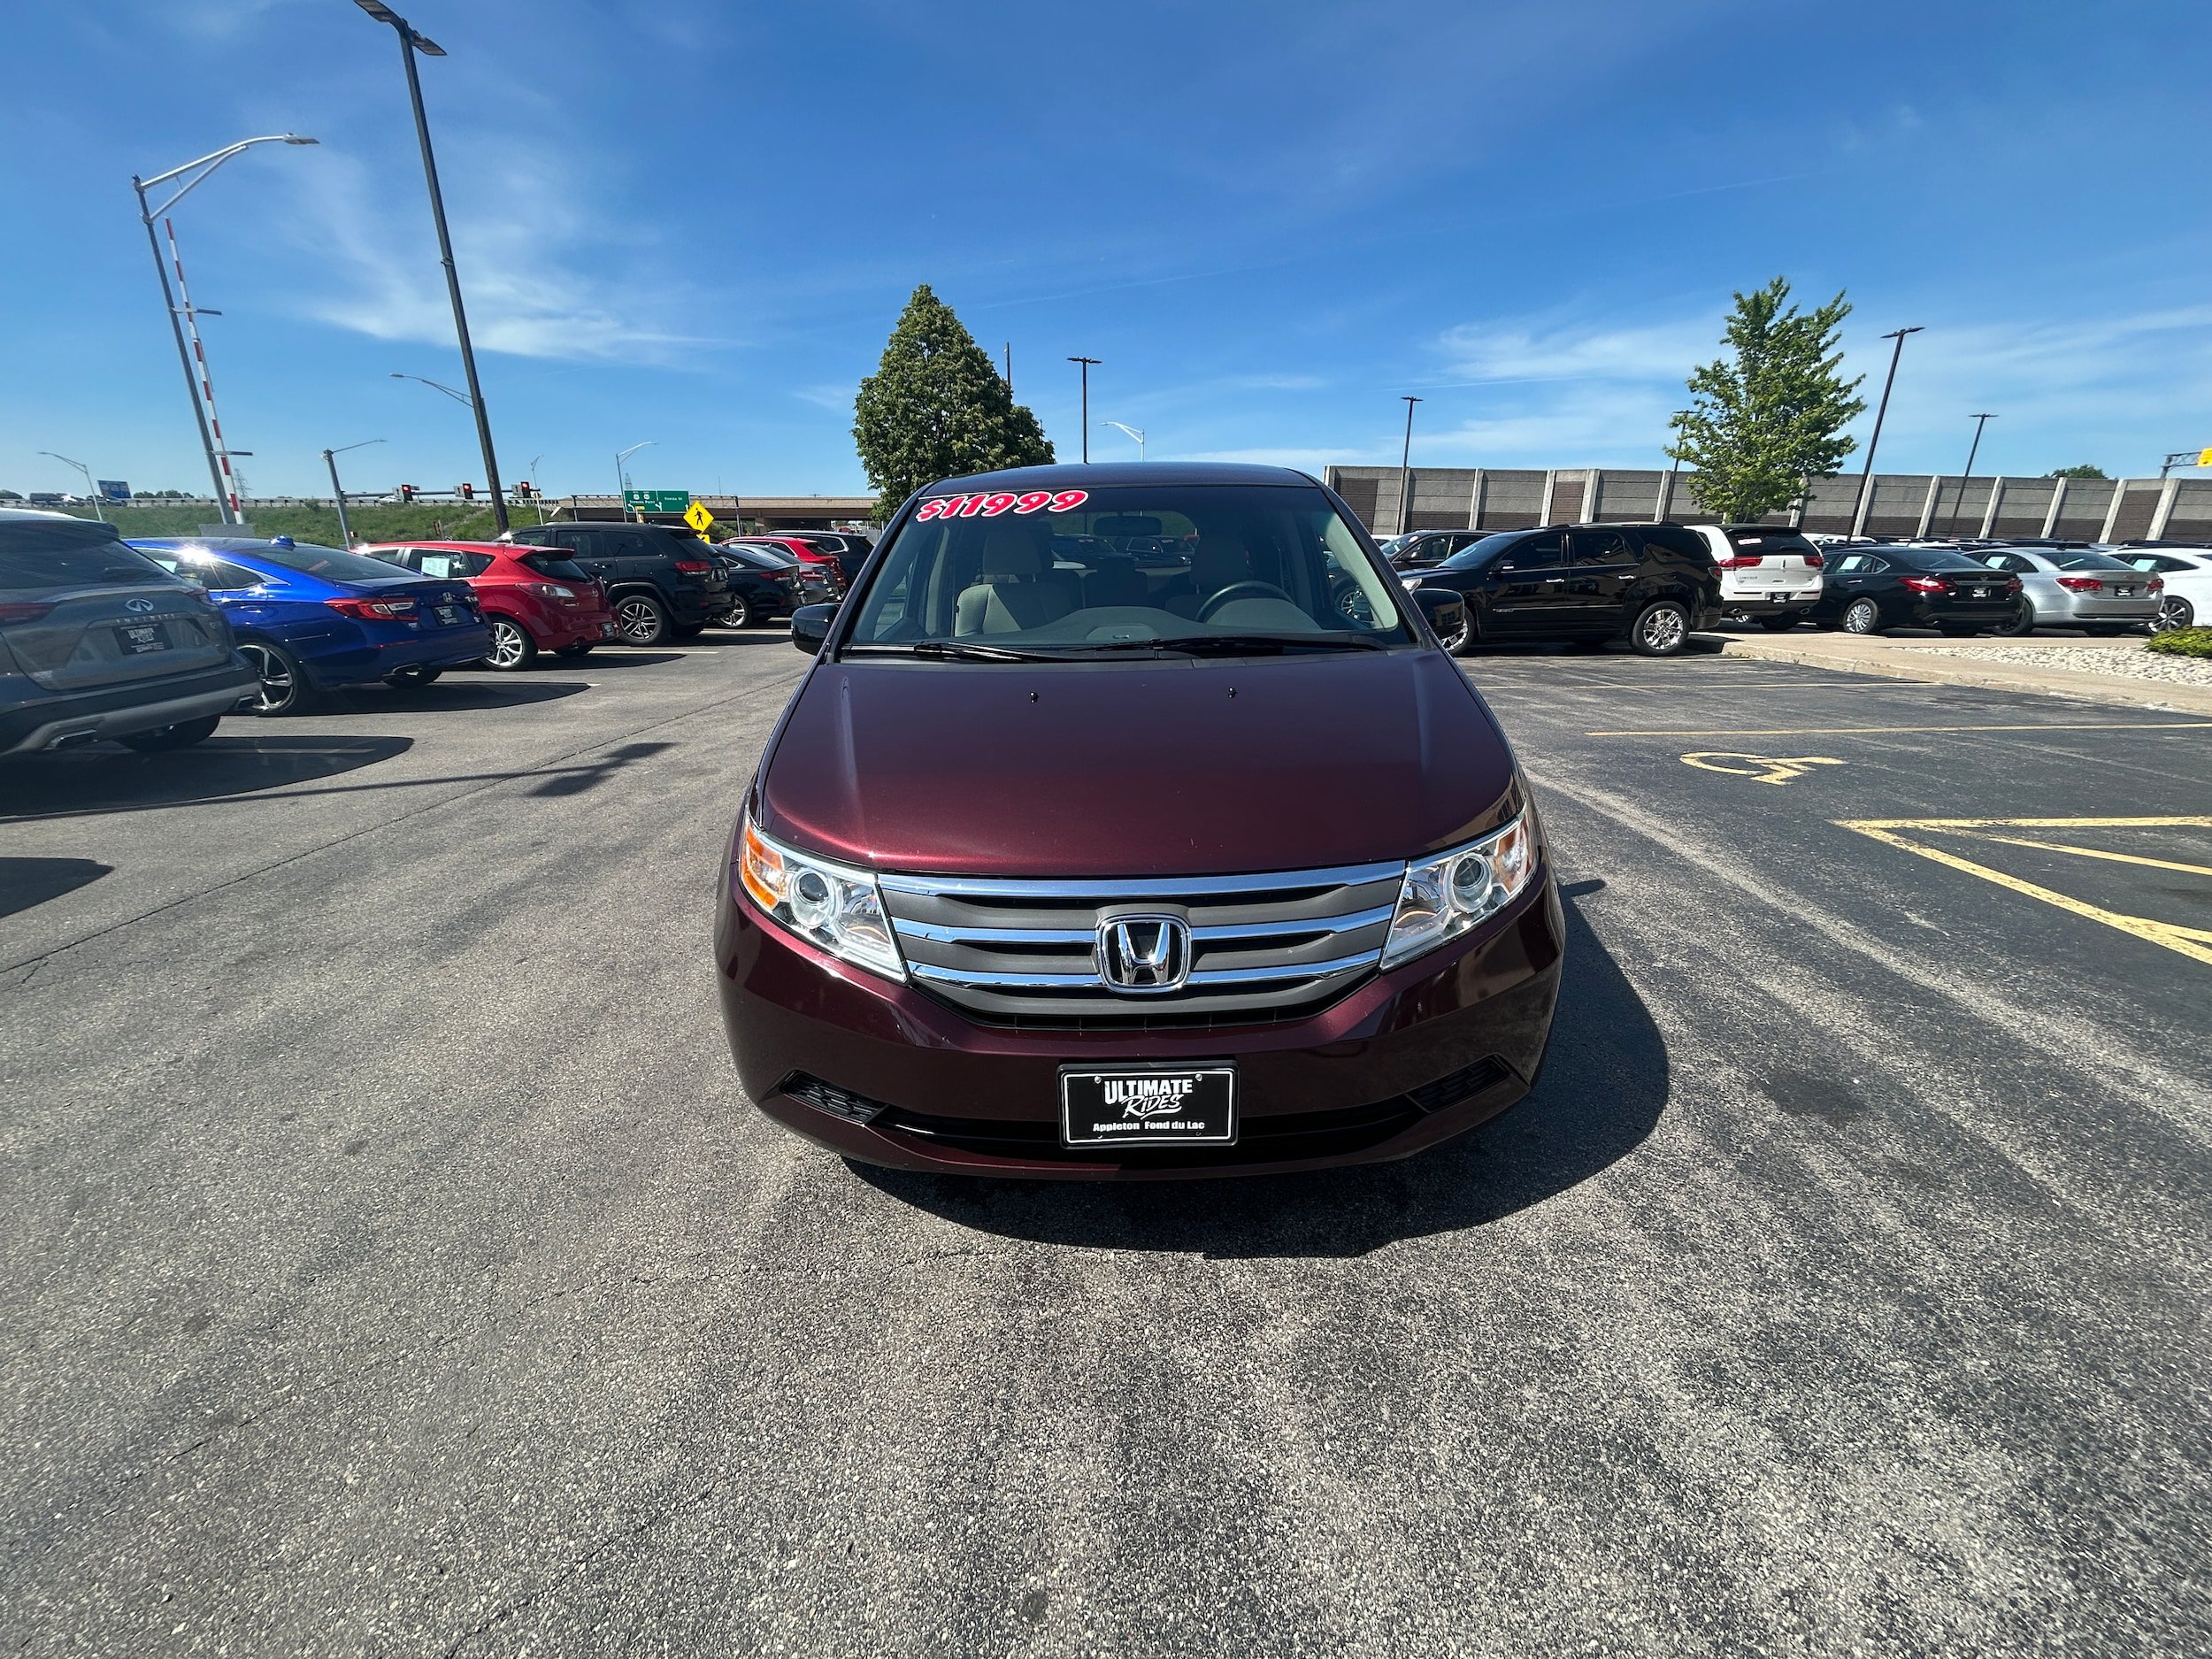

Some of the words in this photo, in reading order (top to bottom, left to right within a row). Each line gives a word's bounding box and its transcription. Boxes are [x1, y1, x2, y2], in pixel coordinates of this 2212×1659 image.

[916, 490, 1088, 523] $11999
[1104, 1079, 1194, 1104] ULTIMATE
[1093, 1122, 1141, 1133] Appleton
